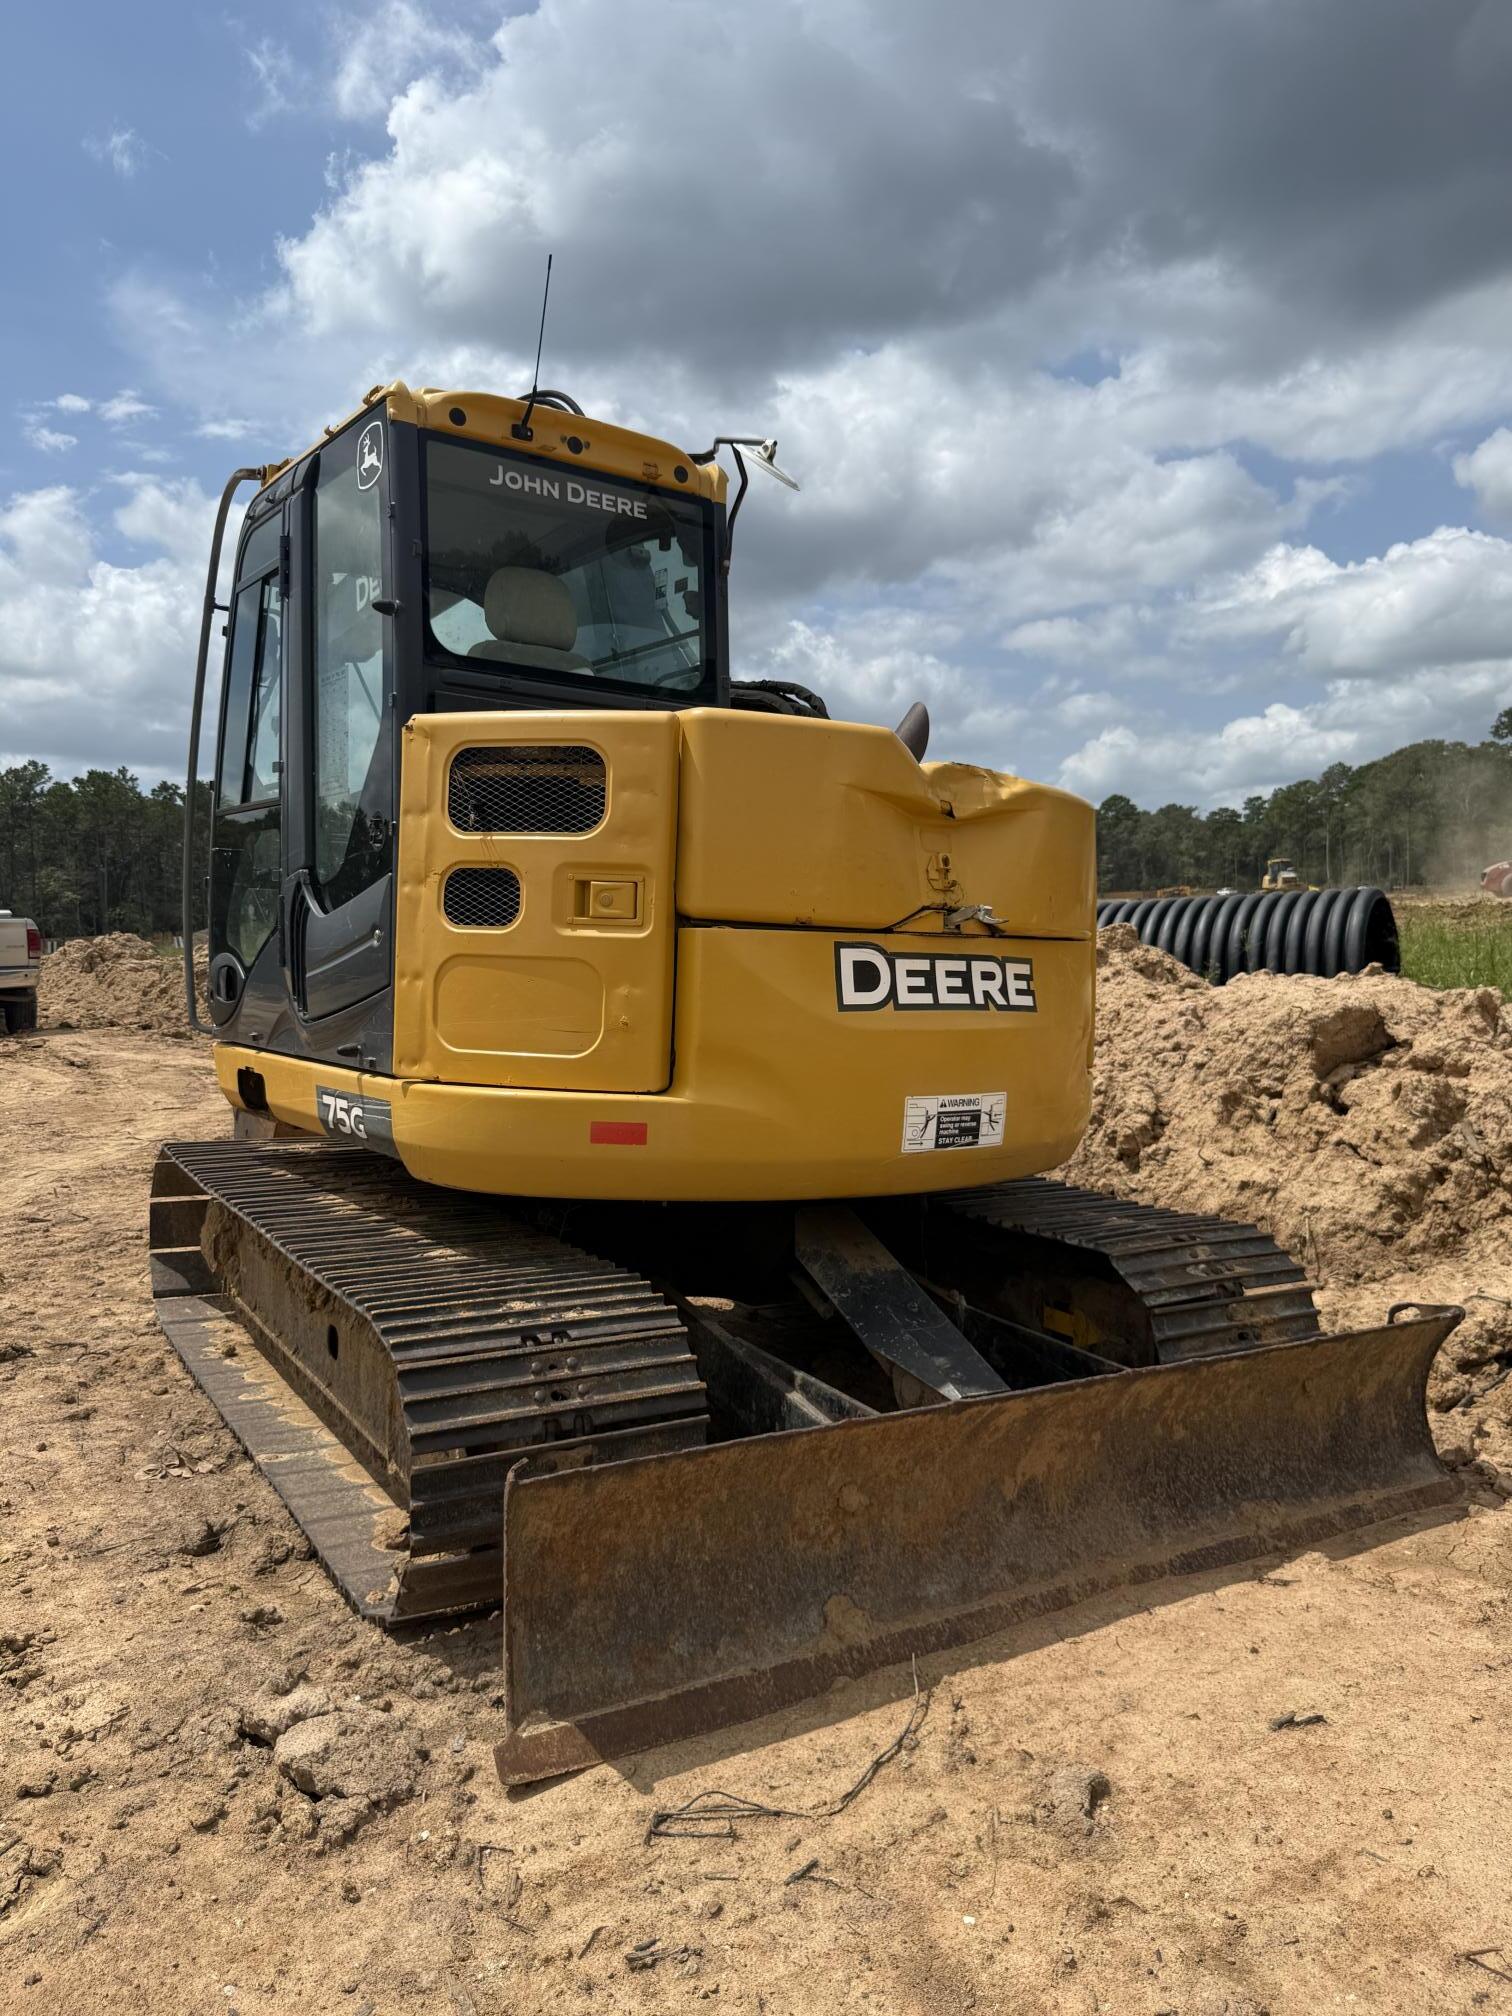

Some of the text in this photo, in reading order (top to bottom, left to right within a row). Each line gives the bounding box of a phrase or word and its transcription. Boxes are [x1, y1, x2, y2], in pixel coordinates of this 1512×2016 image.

[489, 464, 648, 520] JOHN DEERE
[839, 947, 1035, 1007] DEERE
[322, 1094, 368, 1139] 75G
[948, 1097, 980, 1108] WARNING
